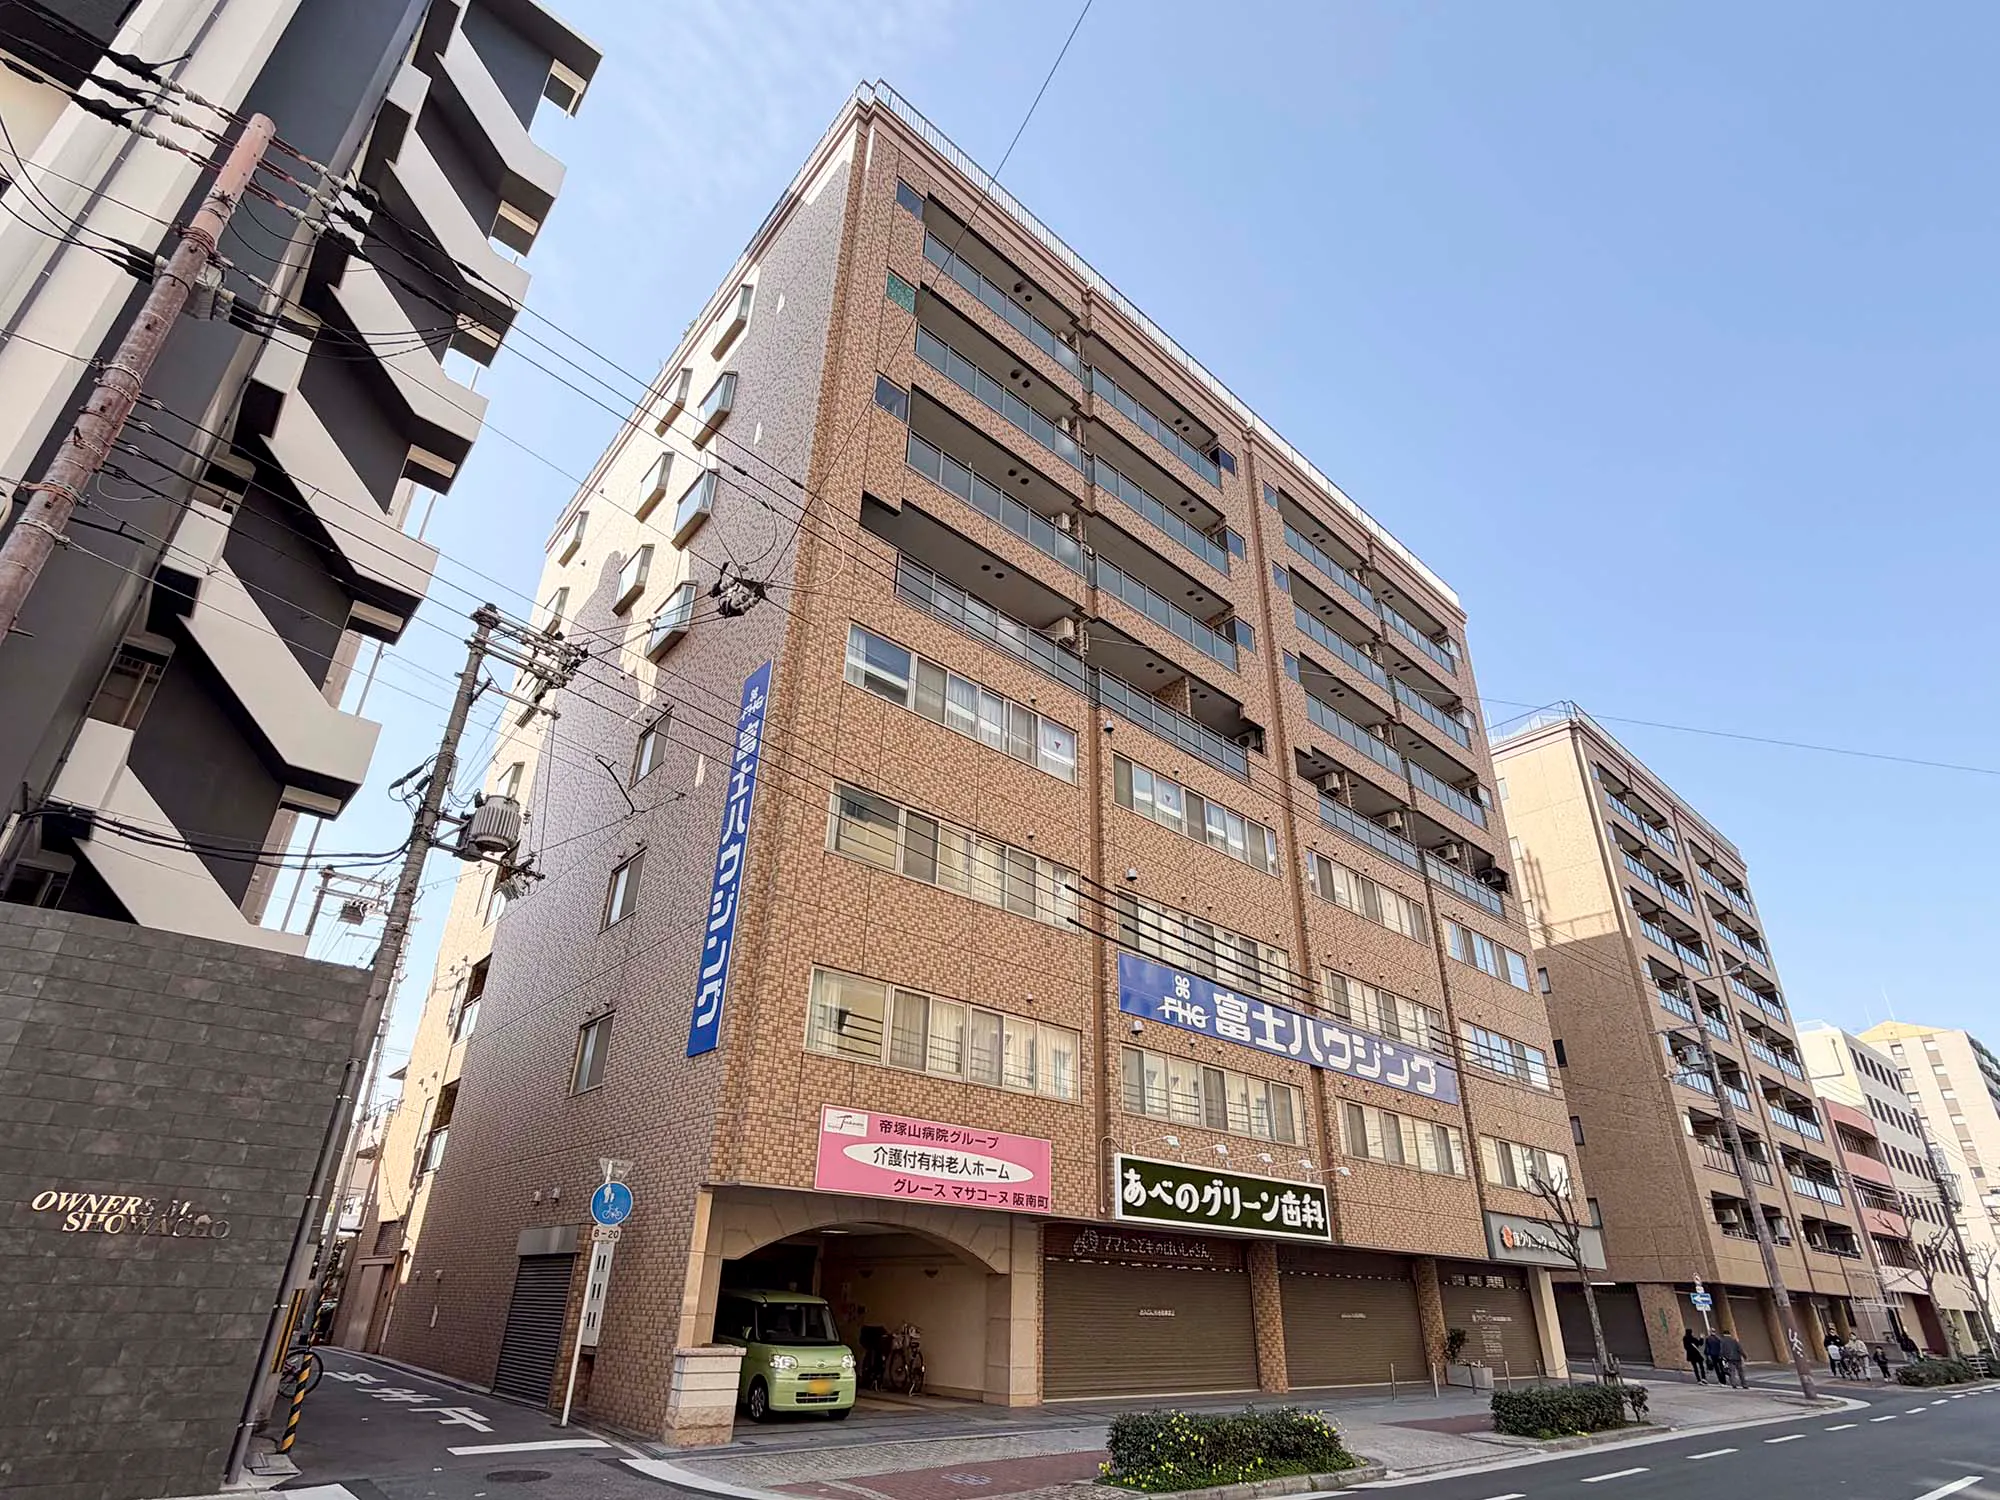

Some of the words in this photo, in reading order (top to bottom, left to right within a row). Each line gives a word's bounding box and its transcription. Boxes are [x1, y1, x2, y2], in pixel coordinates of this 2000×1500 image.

[696, 719, 760, 1028] 富士ハウジング
[1156, 995, 1211, 1029] FHG
[1213, 991, 1438, 1095] 富士ハウジング
[879, 1119, 1000, 1150] 帝塚山病院グループ
[873, 1146, 1010, 1181] 介護付有料老人ホーム
[32, 1190, 160, 1217] OWNERS
[893, 1178, 946, 1198] グレース
[951, 1185, 1009, 1204] マサコーヌ
[1012, 1192, 1049, 1209] 阪南町
[1123, 1167, 1325, 1231] あべのグリーン歯科
